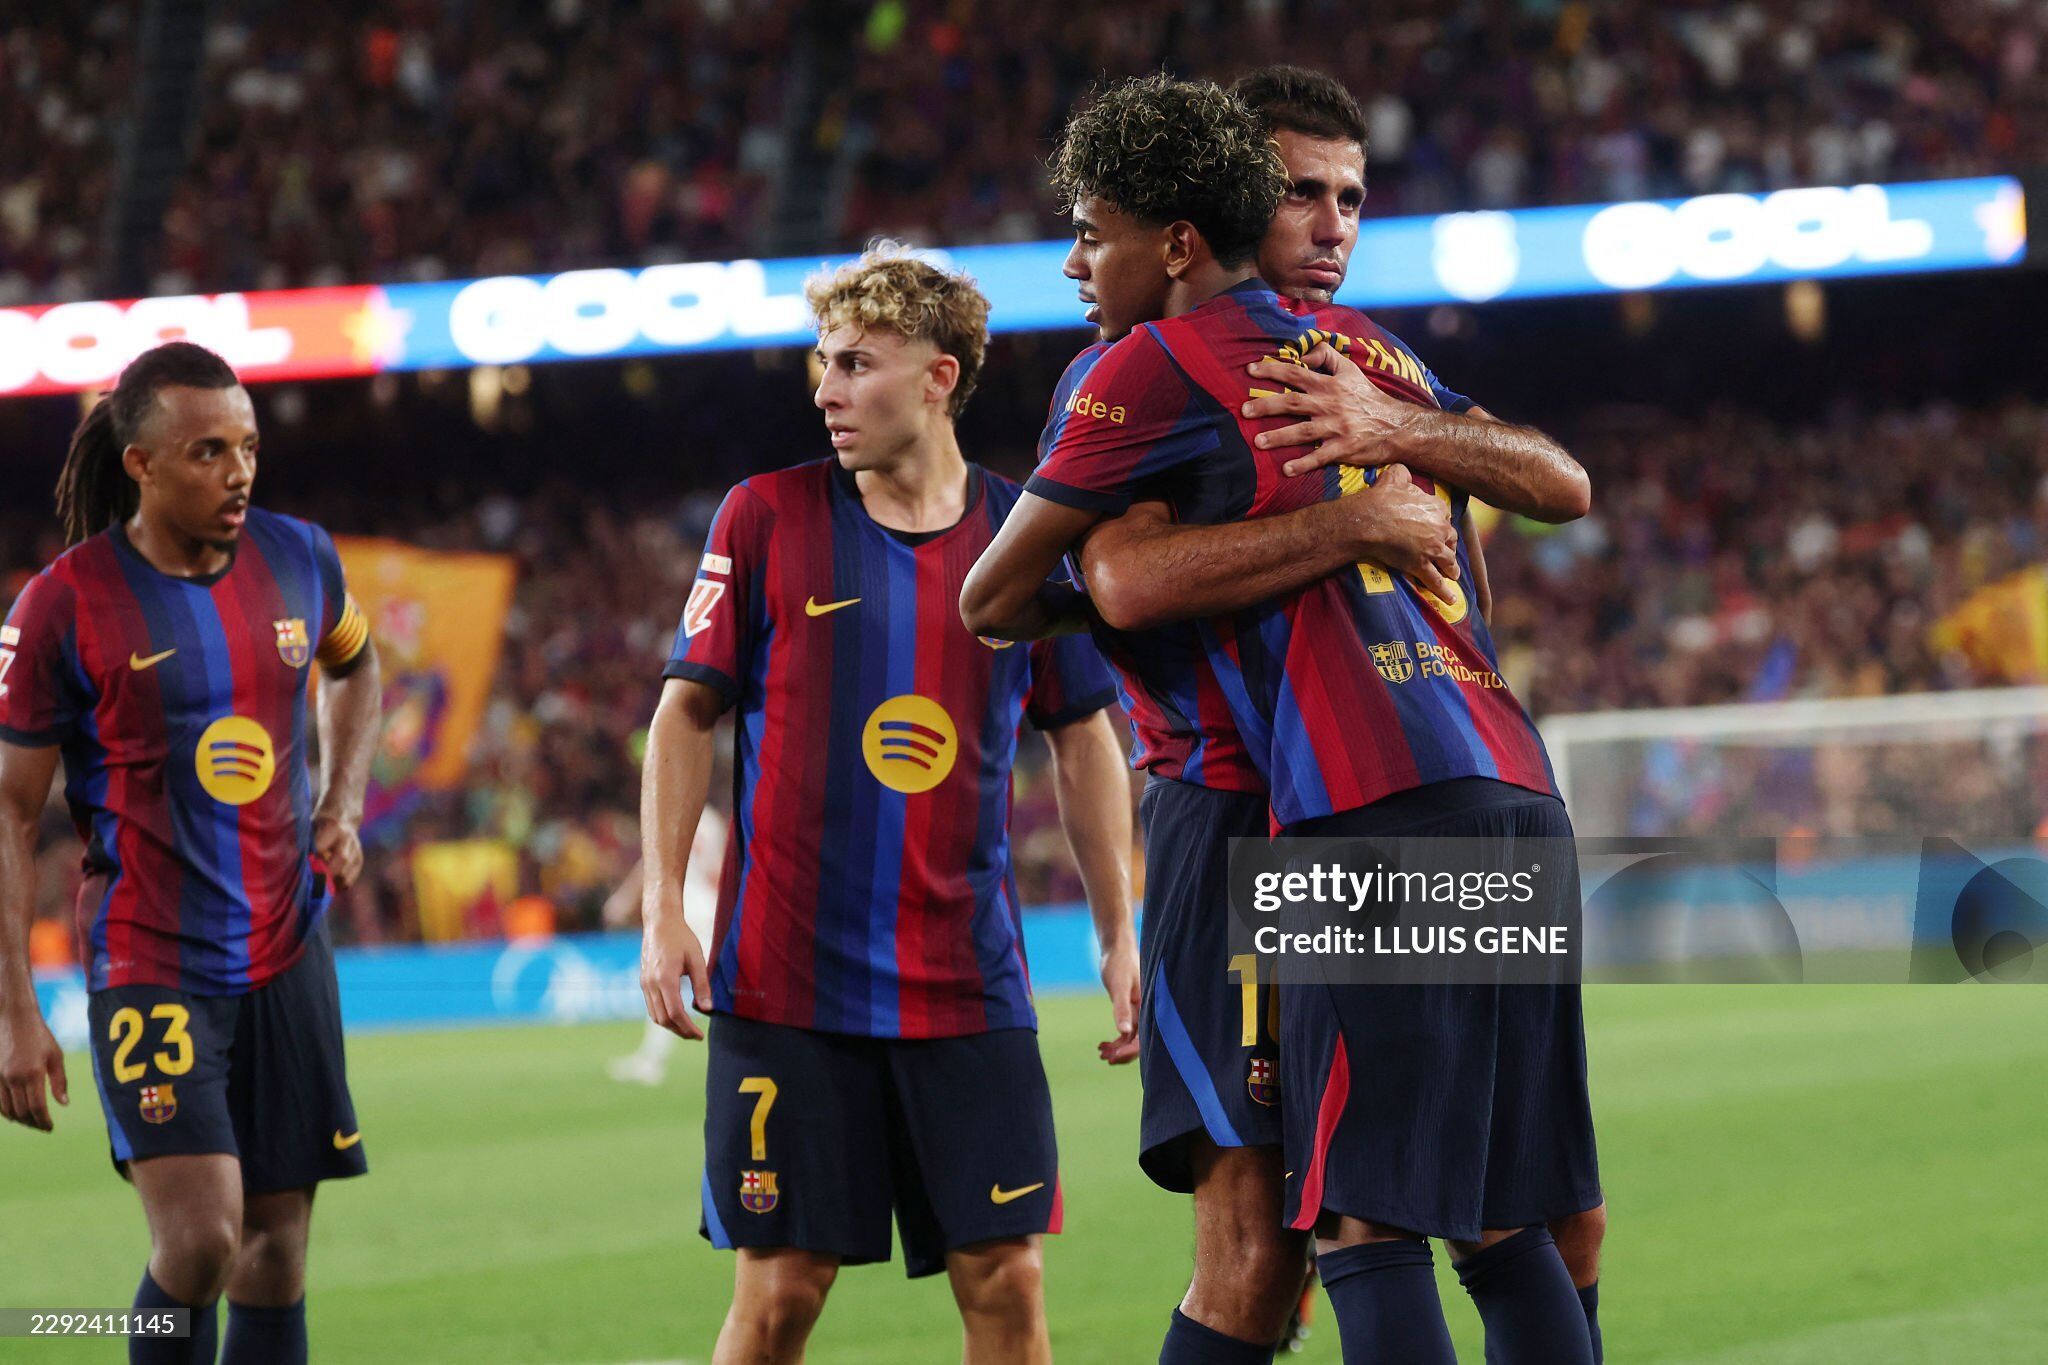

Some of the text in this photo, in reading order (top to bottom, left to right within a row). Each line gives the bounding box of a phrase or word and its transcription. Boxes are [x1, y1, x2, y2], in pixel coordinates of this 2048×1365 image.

[1356, 336, 1434, 400] YAM
[1065, 389, 1126, 424] idea
[109, 1003, 195, 1085] 23
[738, 1077, 778, 1161] 7
